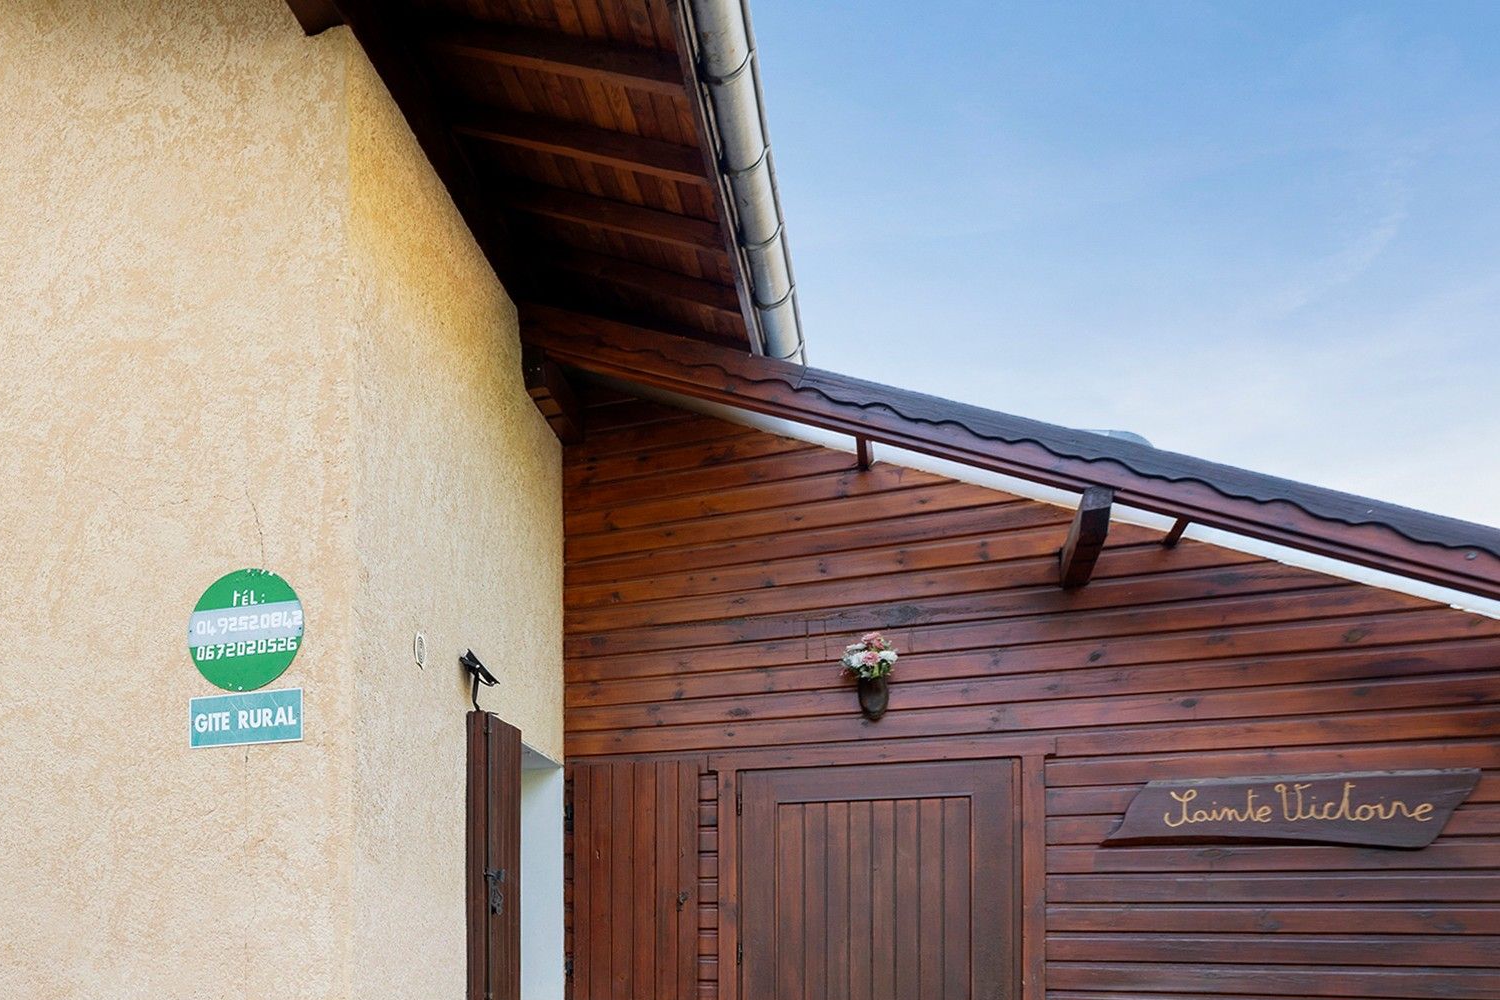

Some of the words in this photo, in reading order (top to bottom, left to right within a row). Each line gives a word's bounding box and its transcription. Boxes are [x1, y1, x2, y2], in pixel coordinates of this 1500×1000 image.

[197, 638, 297, 662] 0672020526
[194, 711, 231, 733] GITE
[238, 707, 297, 730] RURAL
[1165, 788, 1272, 827] Sainte
[1274, 781, 1434, 822] Victoire
